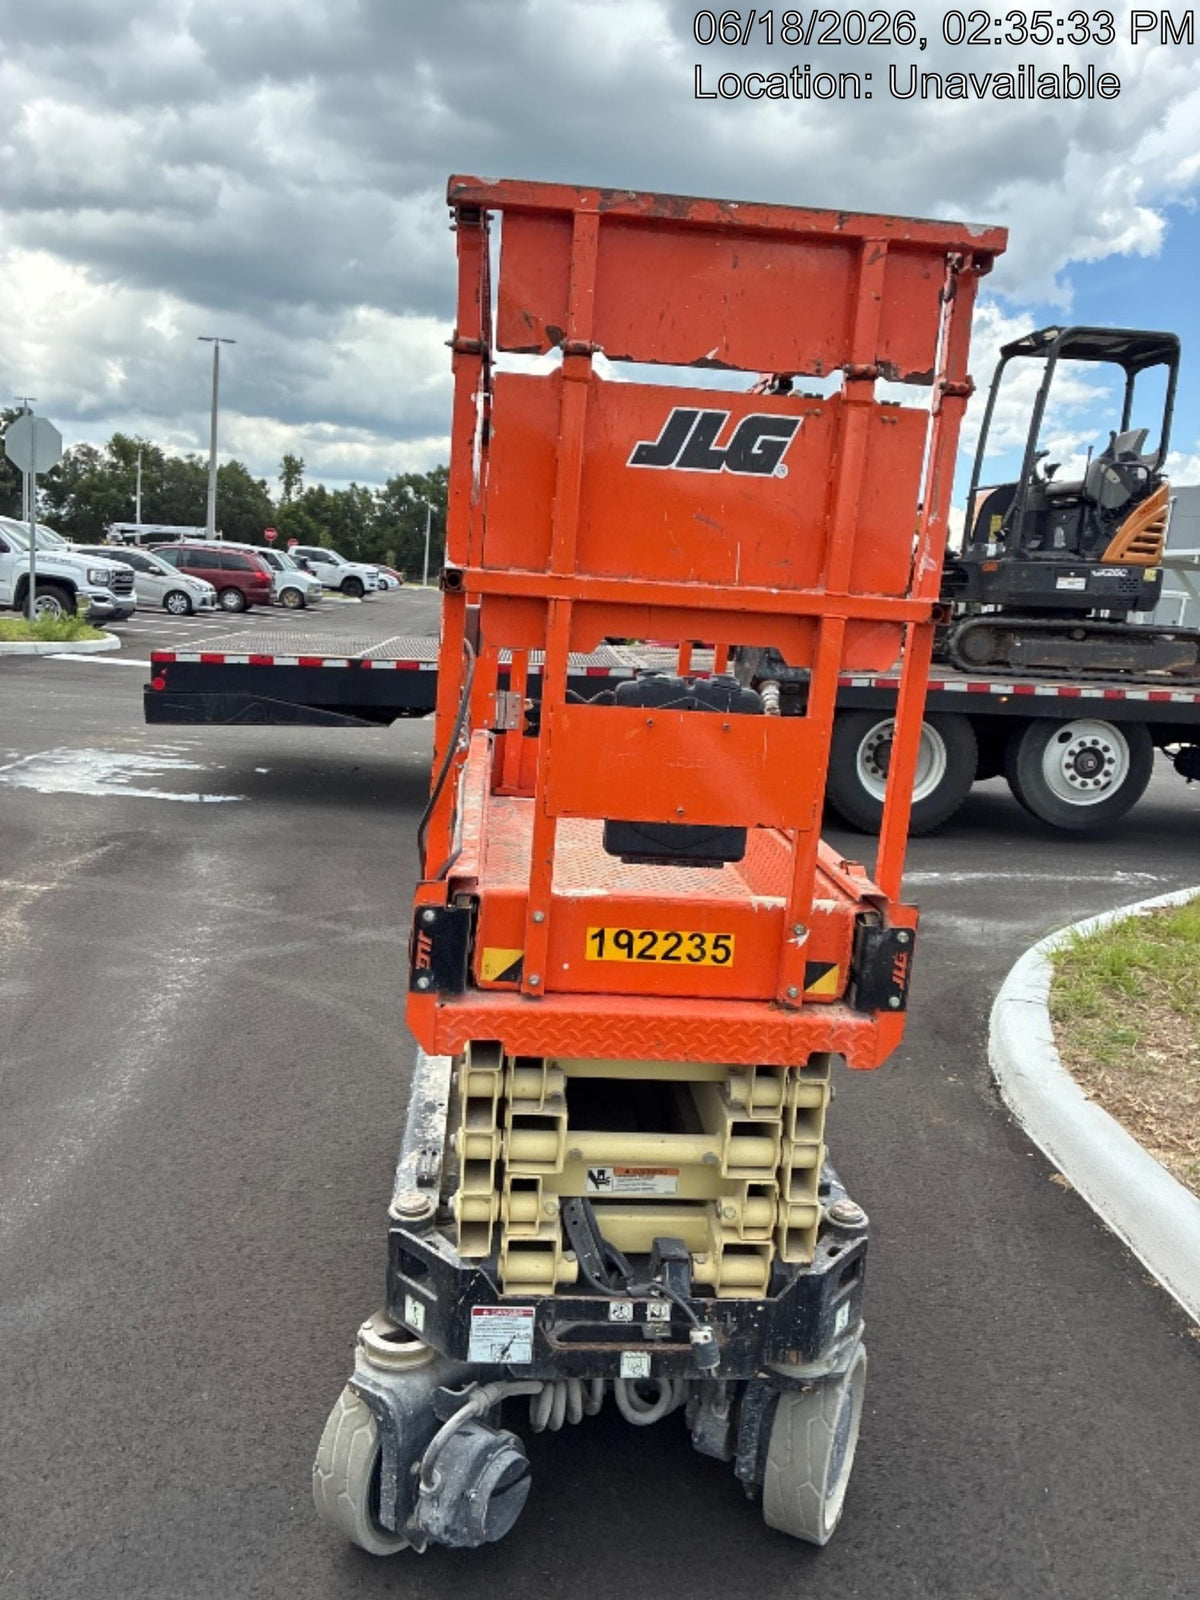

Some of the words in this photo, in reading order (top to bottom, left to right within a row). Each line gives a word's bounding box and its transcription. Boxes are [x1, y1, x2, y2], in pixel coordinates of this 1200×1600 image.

[626, 406, 804, 477] JLG
[415, 929, 433, 970] JLG
[590, 928, 732, 965] 192235
[892, 951, 909, 991] JLG
